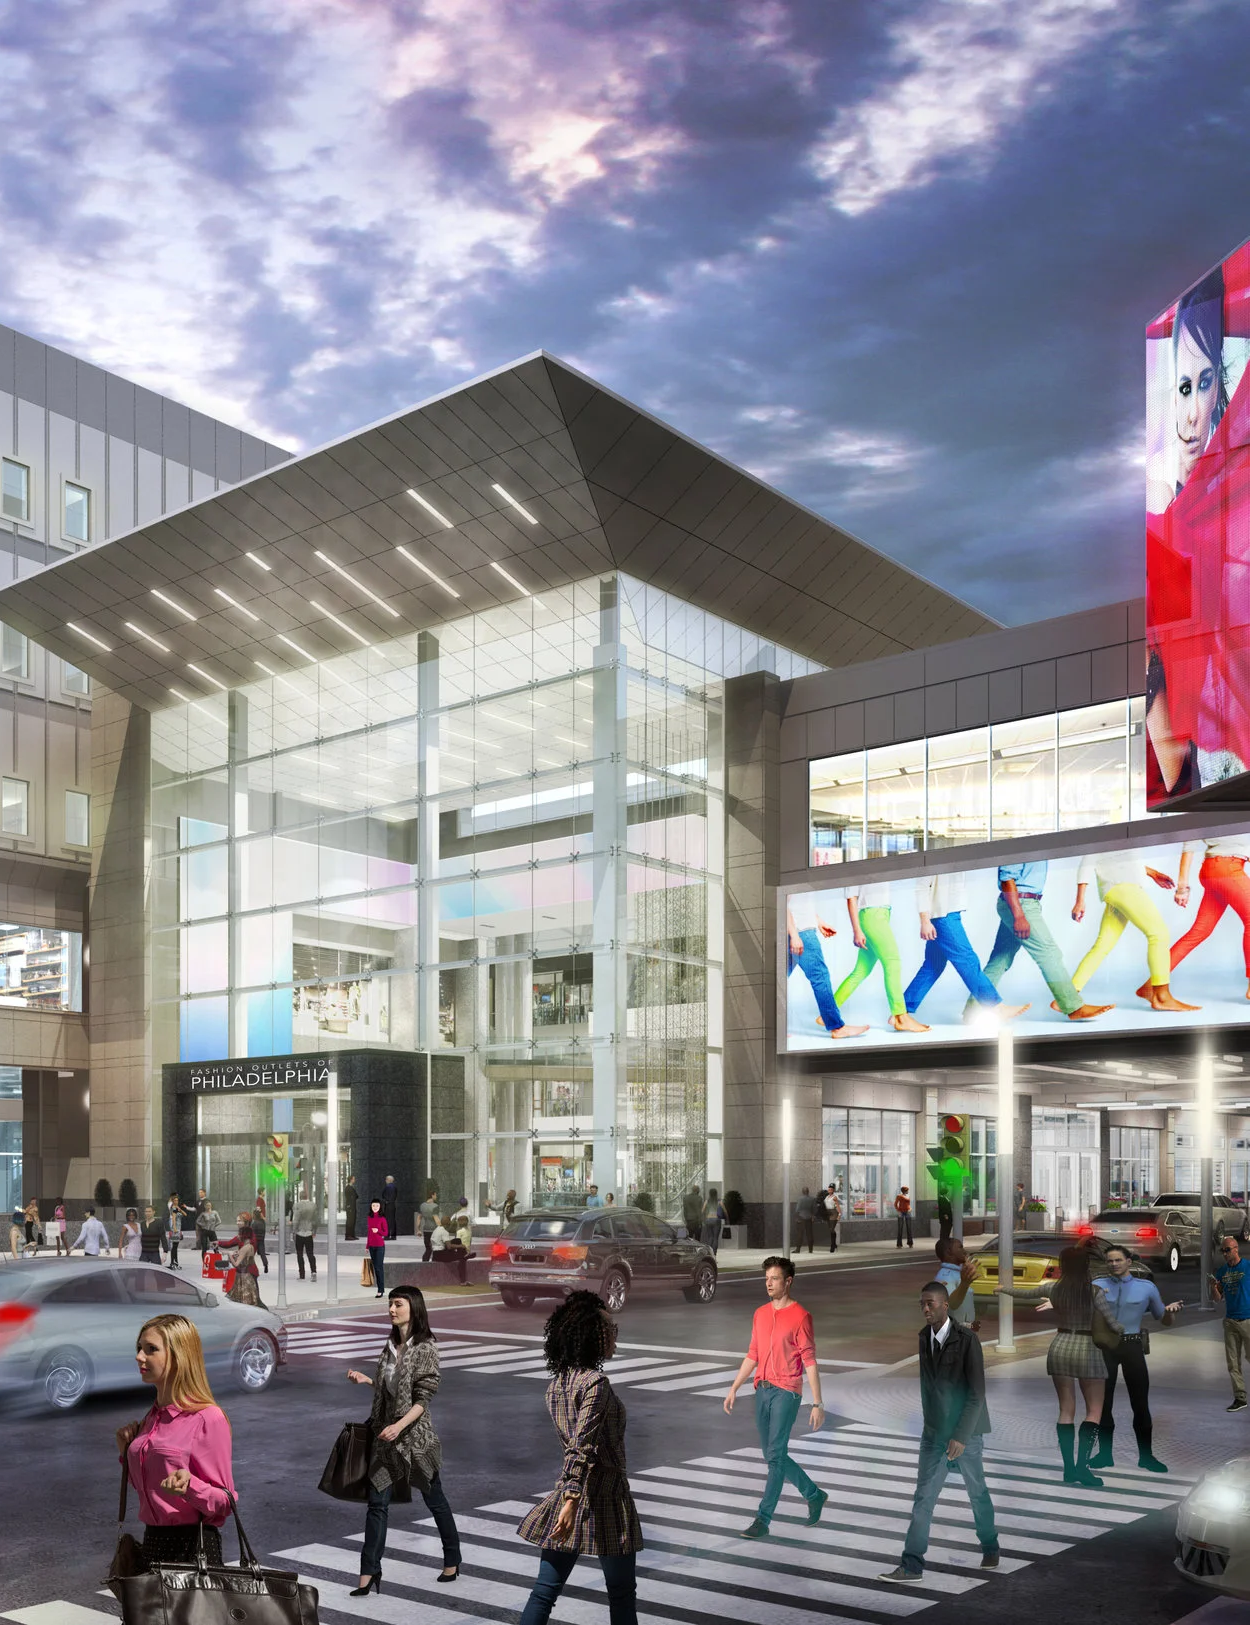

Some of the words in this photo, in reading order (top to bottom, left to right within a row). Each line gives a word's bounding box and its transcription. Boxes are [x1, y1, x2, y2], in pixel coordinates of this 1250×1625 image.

[190, 1065, 243, 1075] FASHION
[252, 1060, 308, 1072] OUTLETS
[317, 1059, 334, 1067] OF
[191, 1067, 330, 1090] PHILADELPHIA
